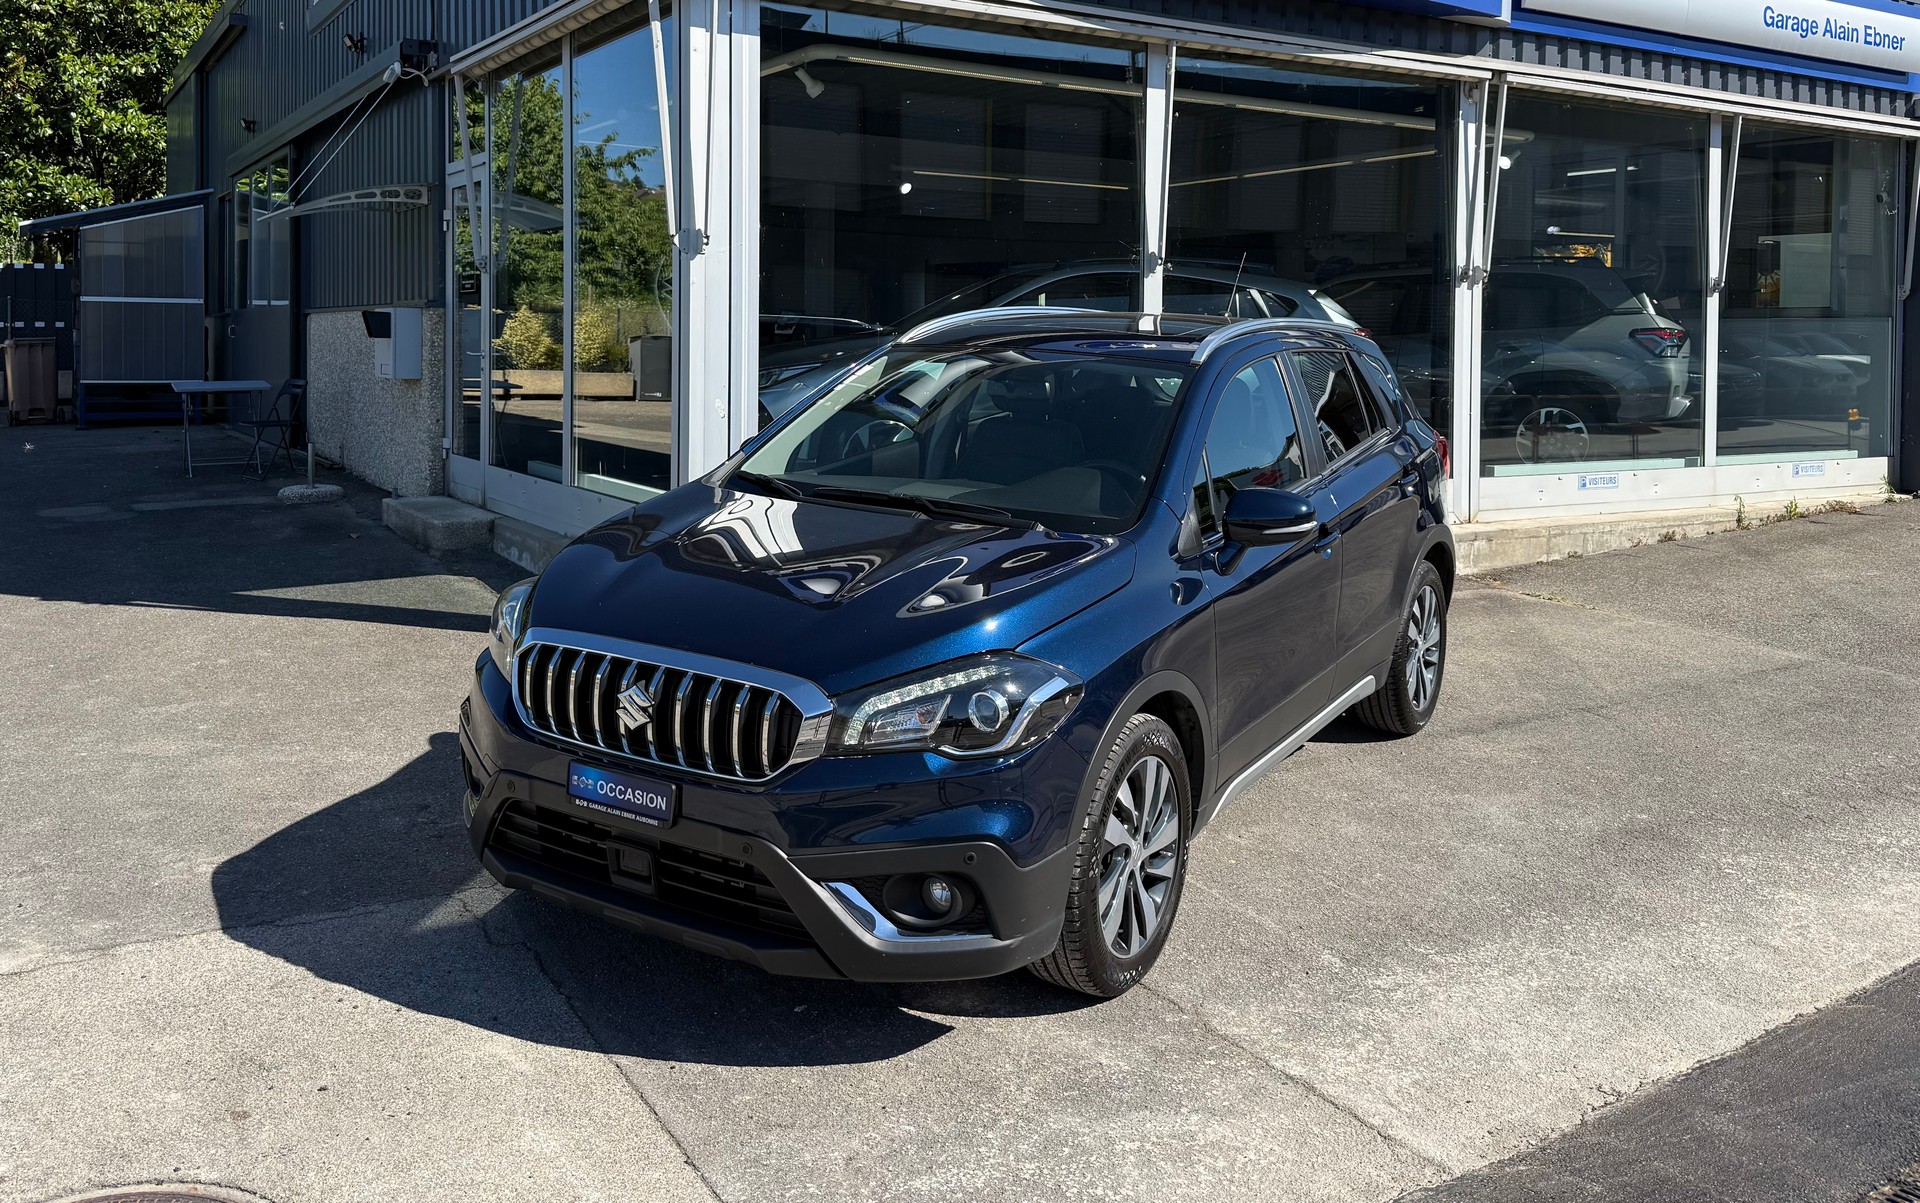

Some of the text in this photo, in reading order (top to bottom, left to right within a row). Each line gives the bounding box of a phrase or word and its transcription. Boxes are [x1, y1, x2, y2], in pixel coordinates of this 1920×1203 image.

[1763, 5, 1906, 51] Garage Alain Ebner
[1801, 464, 1824, 473] VISITEURS
[1588, 476, 1617, 486] VISITEURS
[597, 780, 667, 811] OCCASION
[588, 802, 607, 812] GARAGE
[606, 807, 621, 816] ALAIN
